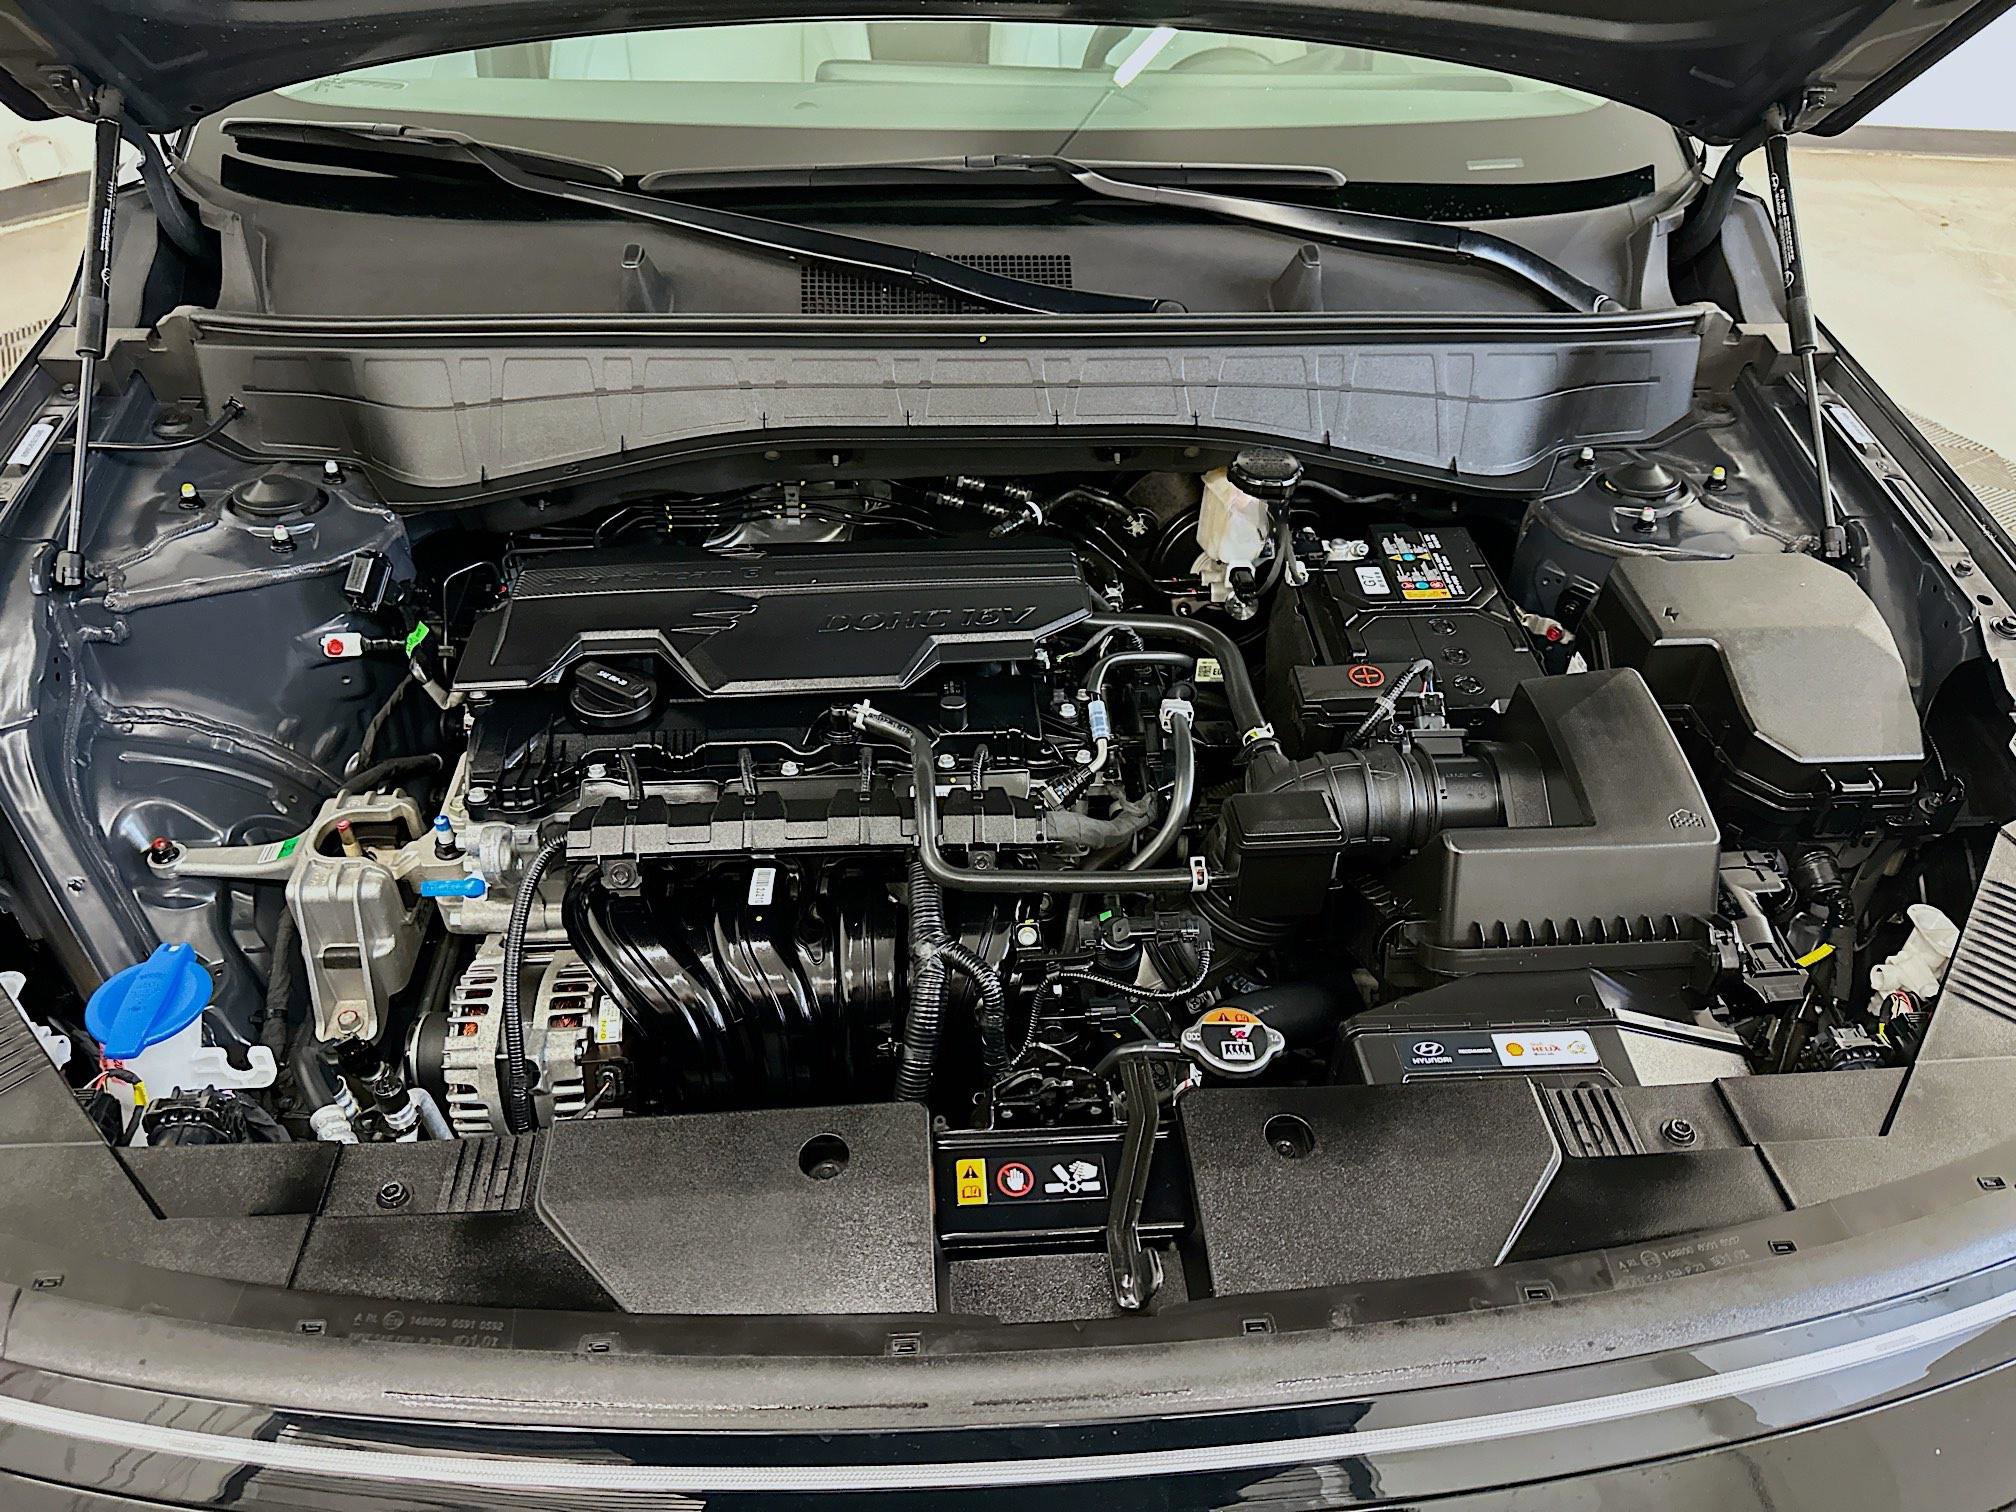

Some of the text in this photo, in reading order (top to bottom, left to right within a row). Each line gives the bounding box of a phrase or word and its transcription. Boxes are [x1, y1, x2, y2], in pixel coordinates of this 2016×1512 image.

[818, 606, 1037, 633] DOHC 16V
[1412, 1056, 1453, 1065] HYUNDAI
